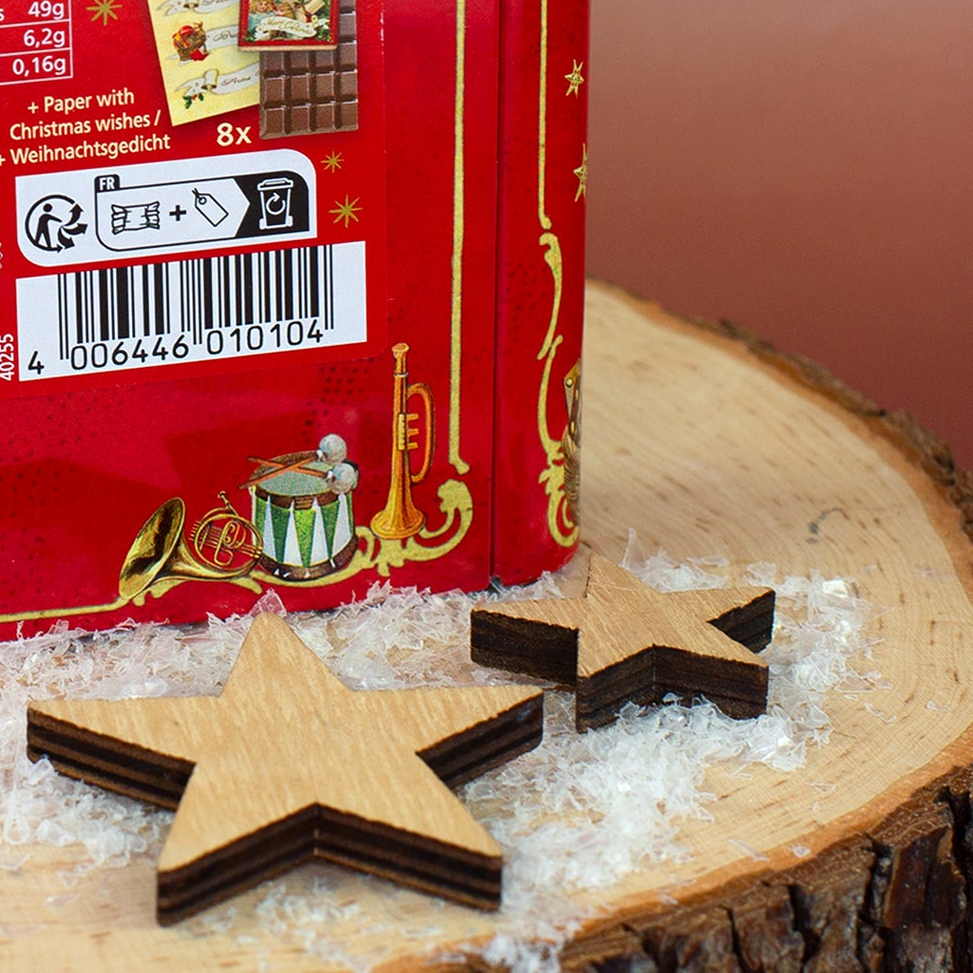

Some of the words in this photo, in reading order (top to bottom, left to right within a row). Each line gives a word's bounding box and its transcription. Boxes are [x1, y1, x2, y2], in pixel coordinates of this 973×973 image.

[28, 0, 64, 20] 49g
[23, 27, 65, 48] 6,2g
[12, 55, 66, 77] 0,16g
[44, 95, 92, 115] Paper
[96, 86, 134, 107] with
[9, 120, 91, 140] Christmas
[94, 112, 151, 132] wishes
[216, 122, 252, 146] 8x
[9, 133, 171, 165] Weihnachtsgedicht
[99, 177, 115, 190] FR
[0, 333, 15, 381] 40255
[28, 350, 45, 374] 4
[70, 334, 189, 369] 006446
[207, 319, 324, 355] 010104
